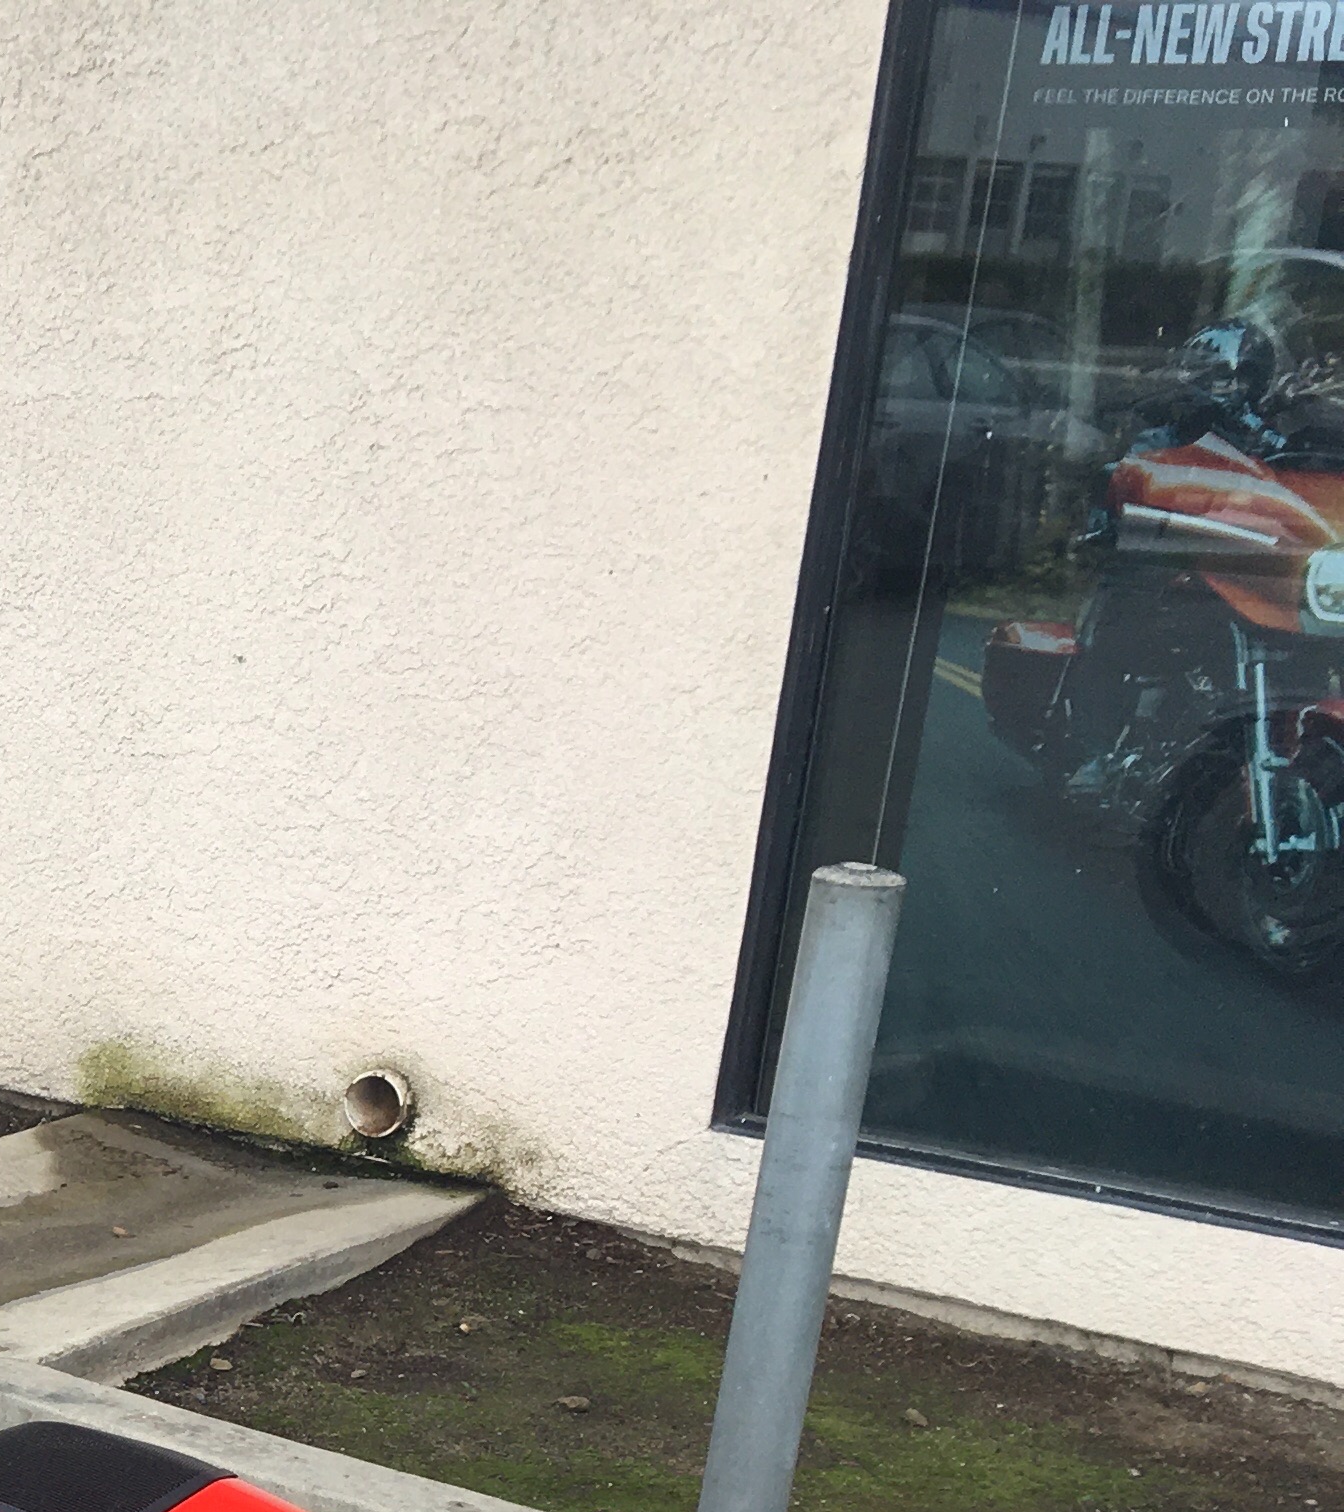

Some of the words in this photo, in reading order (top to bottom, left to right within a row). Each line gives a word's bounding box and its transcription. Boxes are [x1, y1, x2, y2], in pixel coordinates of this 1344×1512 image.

[1040, 3, 1241, 64] ALL-NEW
[1085, 88, 1120, 105] THE
[1123, 88, 1240, 105] DIFFERENCE
[1246, 88, 1274, 104] ON
[1281, 87, 1319, 104] THE
